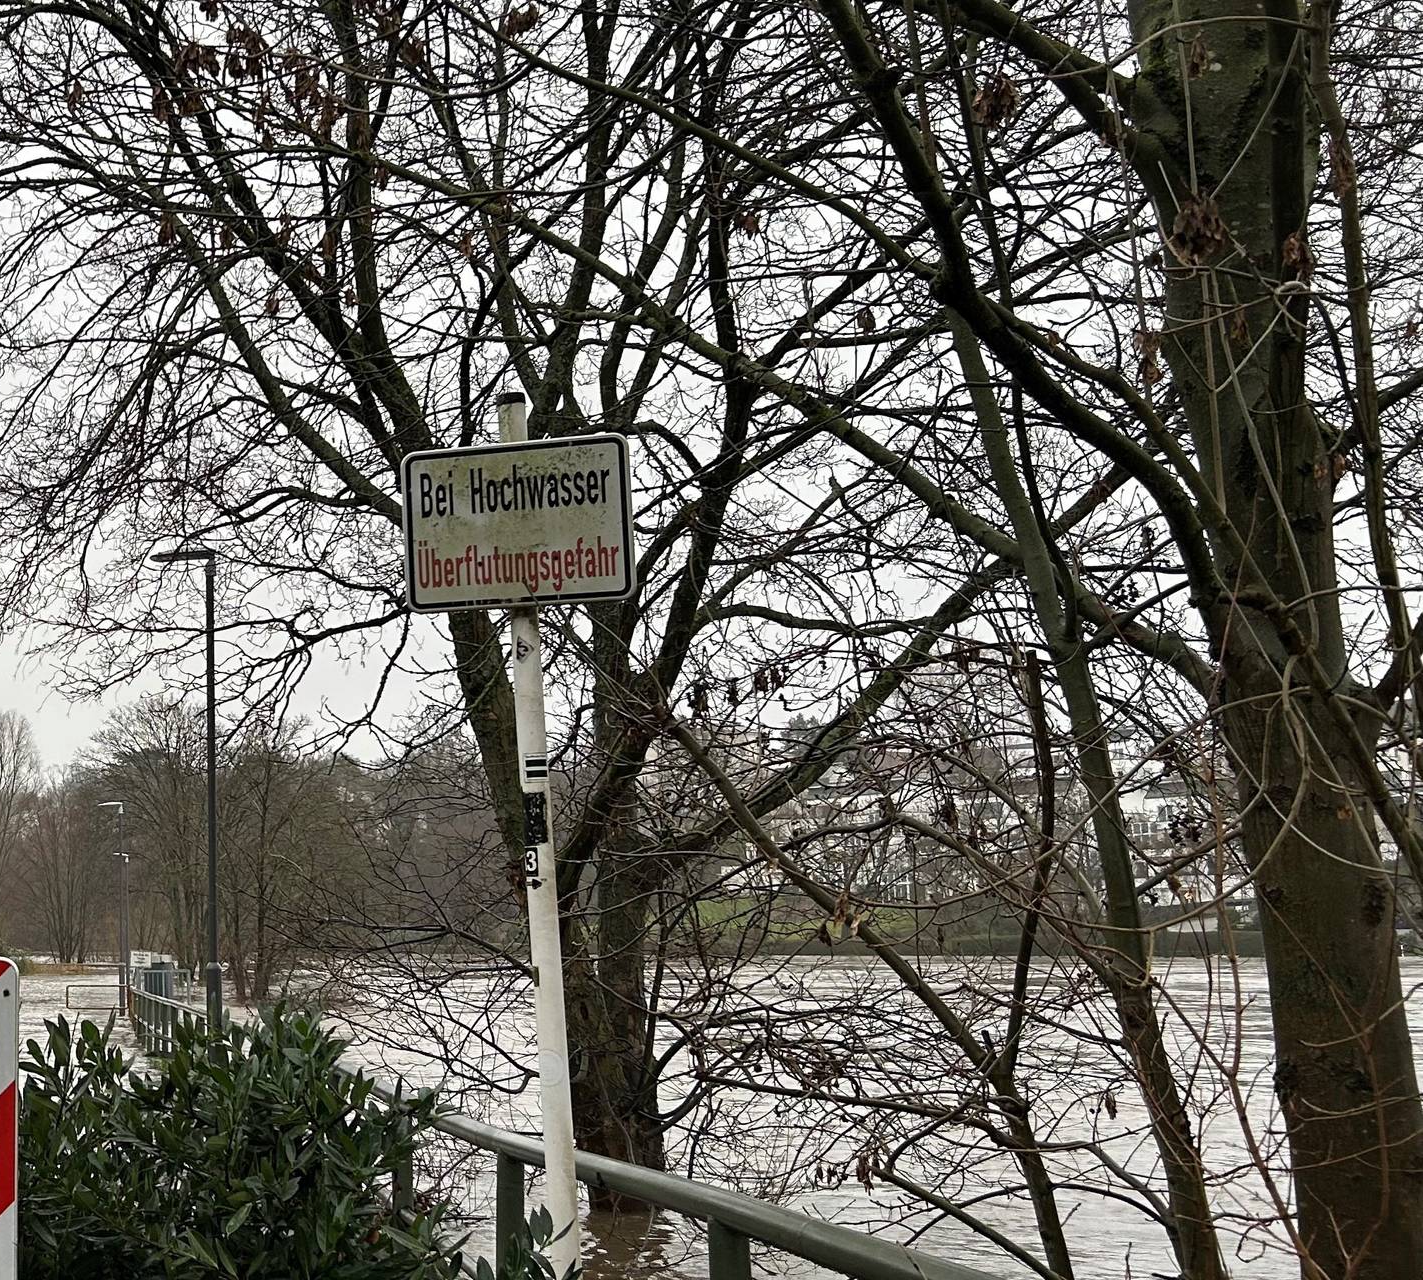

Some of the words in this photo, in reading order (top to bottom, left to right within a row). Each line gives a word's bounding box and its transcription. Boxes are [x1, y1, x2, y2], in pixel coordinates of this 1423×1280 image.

[420, 471, 455, 519] Bei
[470, 464, 610, 514] Hochwasser
[417, 535, 620, 592] Überflutungsgefahr
